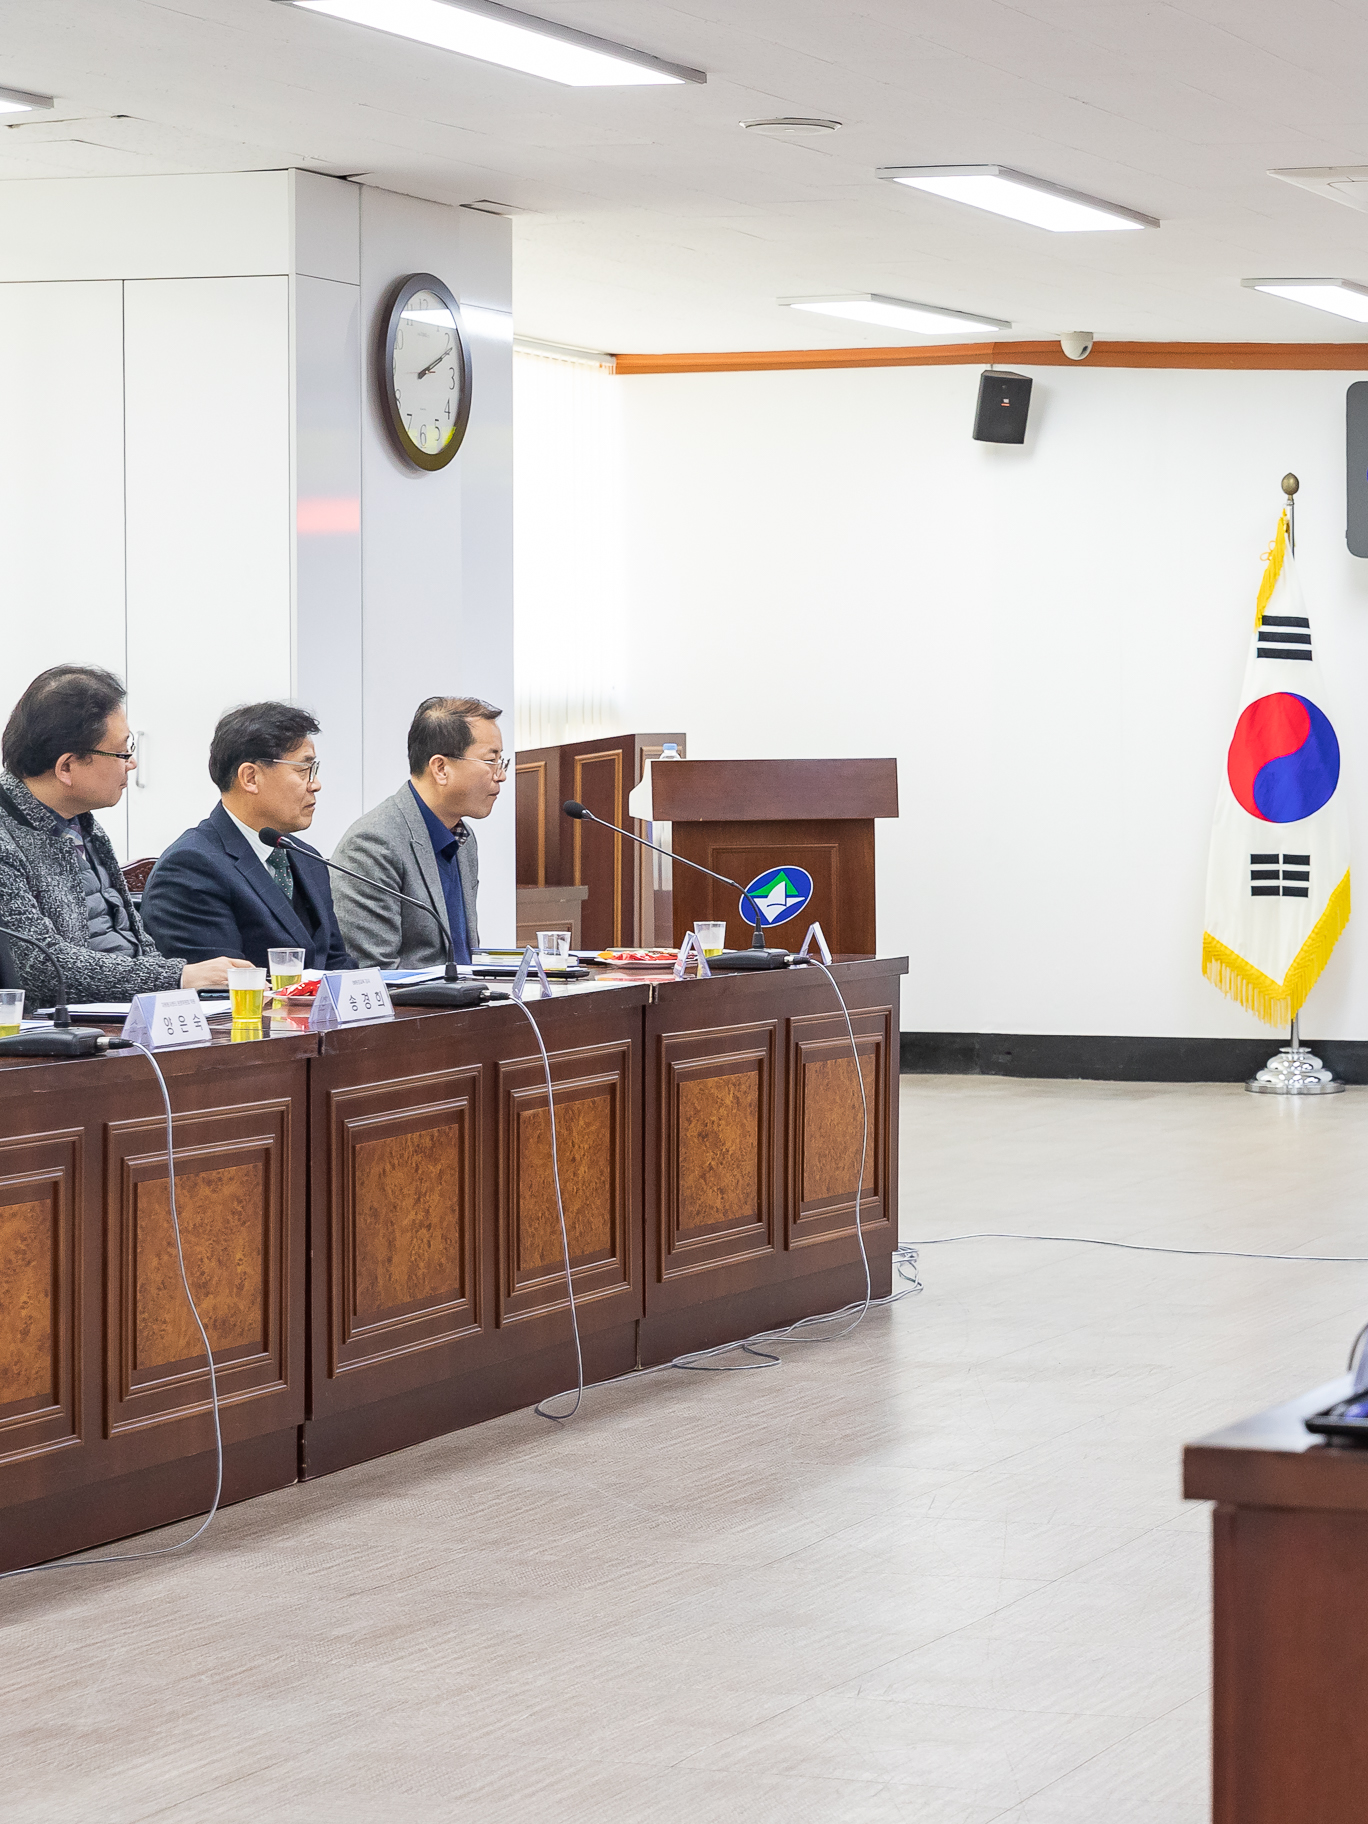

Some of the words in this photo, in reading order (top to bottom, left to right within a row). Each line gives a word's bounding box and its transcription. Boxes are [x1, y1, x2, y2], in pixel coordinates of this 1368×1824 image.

[448, 367, 456, 390] 3
[443, 398, 451, 420] 4
[420, 424, 427, 446] 6
[434, 419, 441, 441] 5
